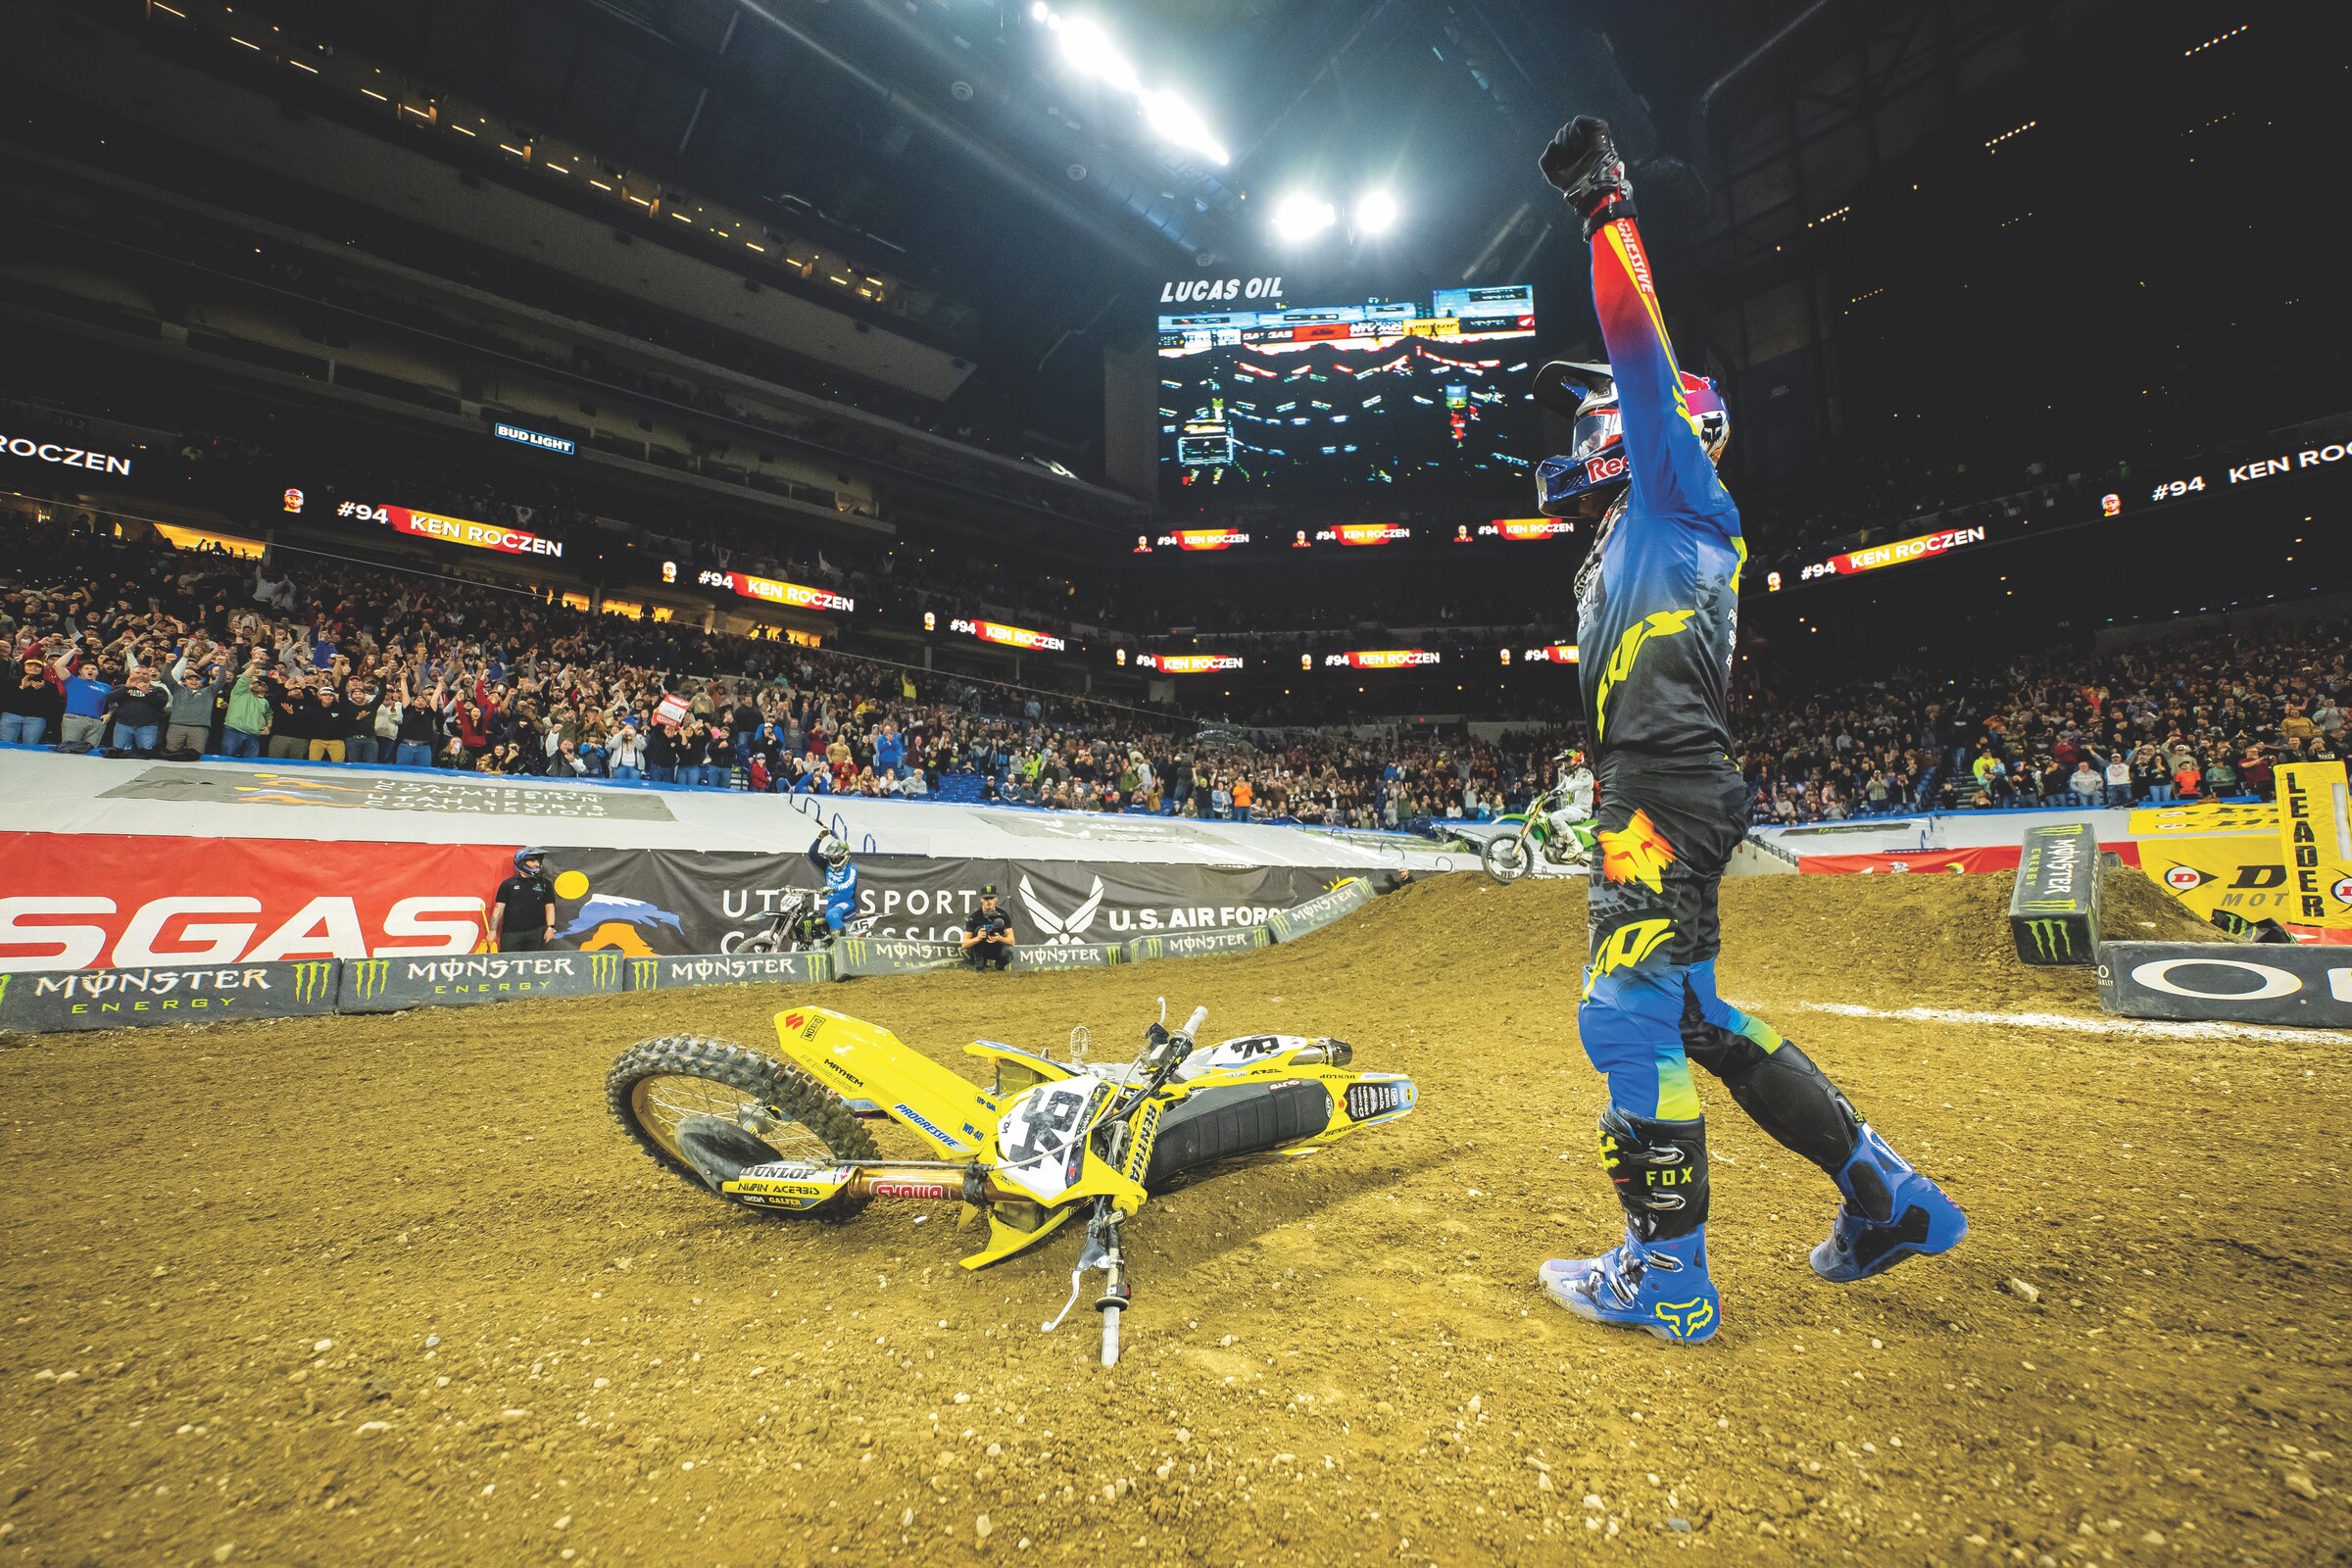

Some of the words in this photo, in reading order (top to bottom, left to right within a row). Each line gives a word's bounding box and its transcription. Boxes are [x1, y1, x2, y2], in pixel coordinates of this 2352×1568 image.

[1160, 278, 1240, 302] LUCAS
[1245, 276, 1283, 298] OIL
[498, 426, 529, 441] BUD
[530, 433, 572, 452] LIGHT
[2152, 475, 2206, 501] #94
[2229, 456, 2290, 484] KEN
[337, 501, 389, 524] #94
[410, 514, 461, 538] KEN
[467, 526, 563, 558] ROCZEN
[1316, 531, 1336, 540] #94
[1344, 530, 1365, 539] KEN
[1367, 528, 1410, 538] ROCZEN
[1478, 525, 1498, 535] #94
[1506, 524, 1528, 534] KEN
[1530, 523, 1574, 533] ROCZEN
[1157, 536, 1177, 545] #94
[1184, 535, 1205, 544] KEN
[1207, 534, 1250, 544] ROCZEN
[1801, 561, 1837, 580] #94
[1850, 549, 1890, 569] KEN
[1895, 526, 1984, 559] ROCZEN
[699, 570, 733, 589] #94
[748, 580, 782, 598] KEN
[787, 587, 855, 612] ROCZEN
[951, 619, 976, 634] #94
[986, 625, 1011, 642] KEN
[1014, 630, 1065, 651] ROCZEN
[1137, 655, 1156, 667] #94
[1163, 659, 1189, 669] KEN
[1192, 657, 1243, 669] ROCZEN
[1326, 654, 1349, 666] #94
[1359, 653, 1384, 666] KEN
[1388, 651, 1441, 666] ROCZEN
[1524, 649, 1549, 661] #94
[1559, 649, 1579, 660] KE
[364, 801, 605, 816] COMMISSION
[368, 794, 463, 805] UTAH
[2286, 772, 2325, 917] LEADER
[2026, 848, 2042, 886] ENERGY
[859, 889, 977, 915] SPORT
[2221, 893, 2288, 906] MOT
[1109, 909, 1164, 930] U.S.
[1168, 907, 1215, 928] AIR
[434, 981, 550, 994] ENERGY
[72, 998, 236, 1014] ENERGY
[824, 1057, 864, 1088] MAYHEM
[976, 1095, 997, 1112] WD-40
[894, 1102, 959, 1149] PROGRESSIVE
[962, 1121, 984, 1141] WD-40
[1008, 1088, 1085, 1172] 94
[1323, 1123, 1361, 1137] DUNLOP
[1128, 1102, 1157, 1182] RENTHA
[739, 1166, 817, 1180] DUNLOP
[1645, 1167, 1693, 1186] FOX
[768, 1197, 802, 1206] GALFER
